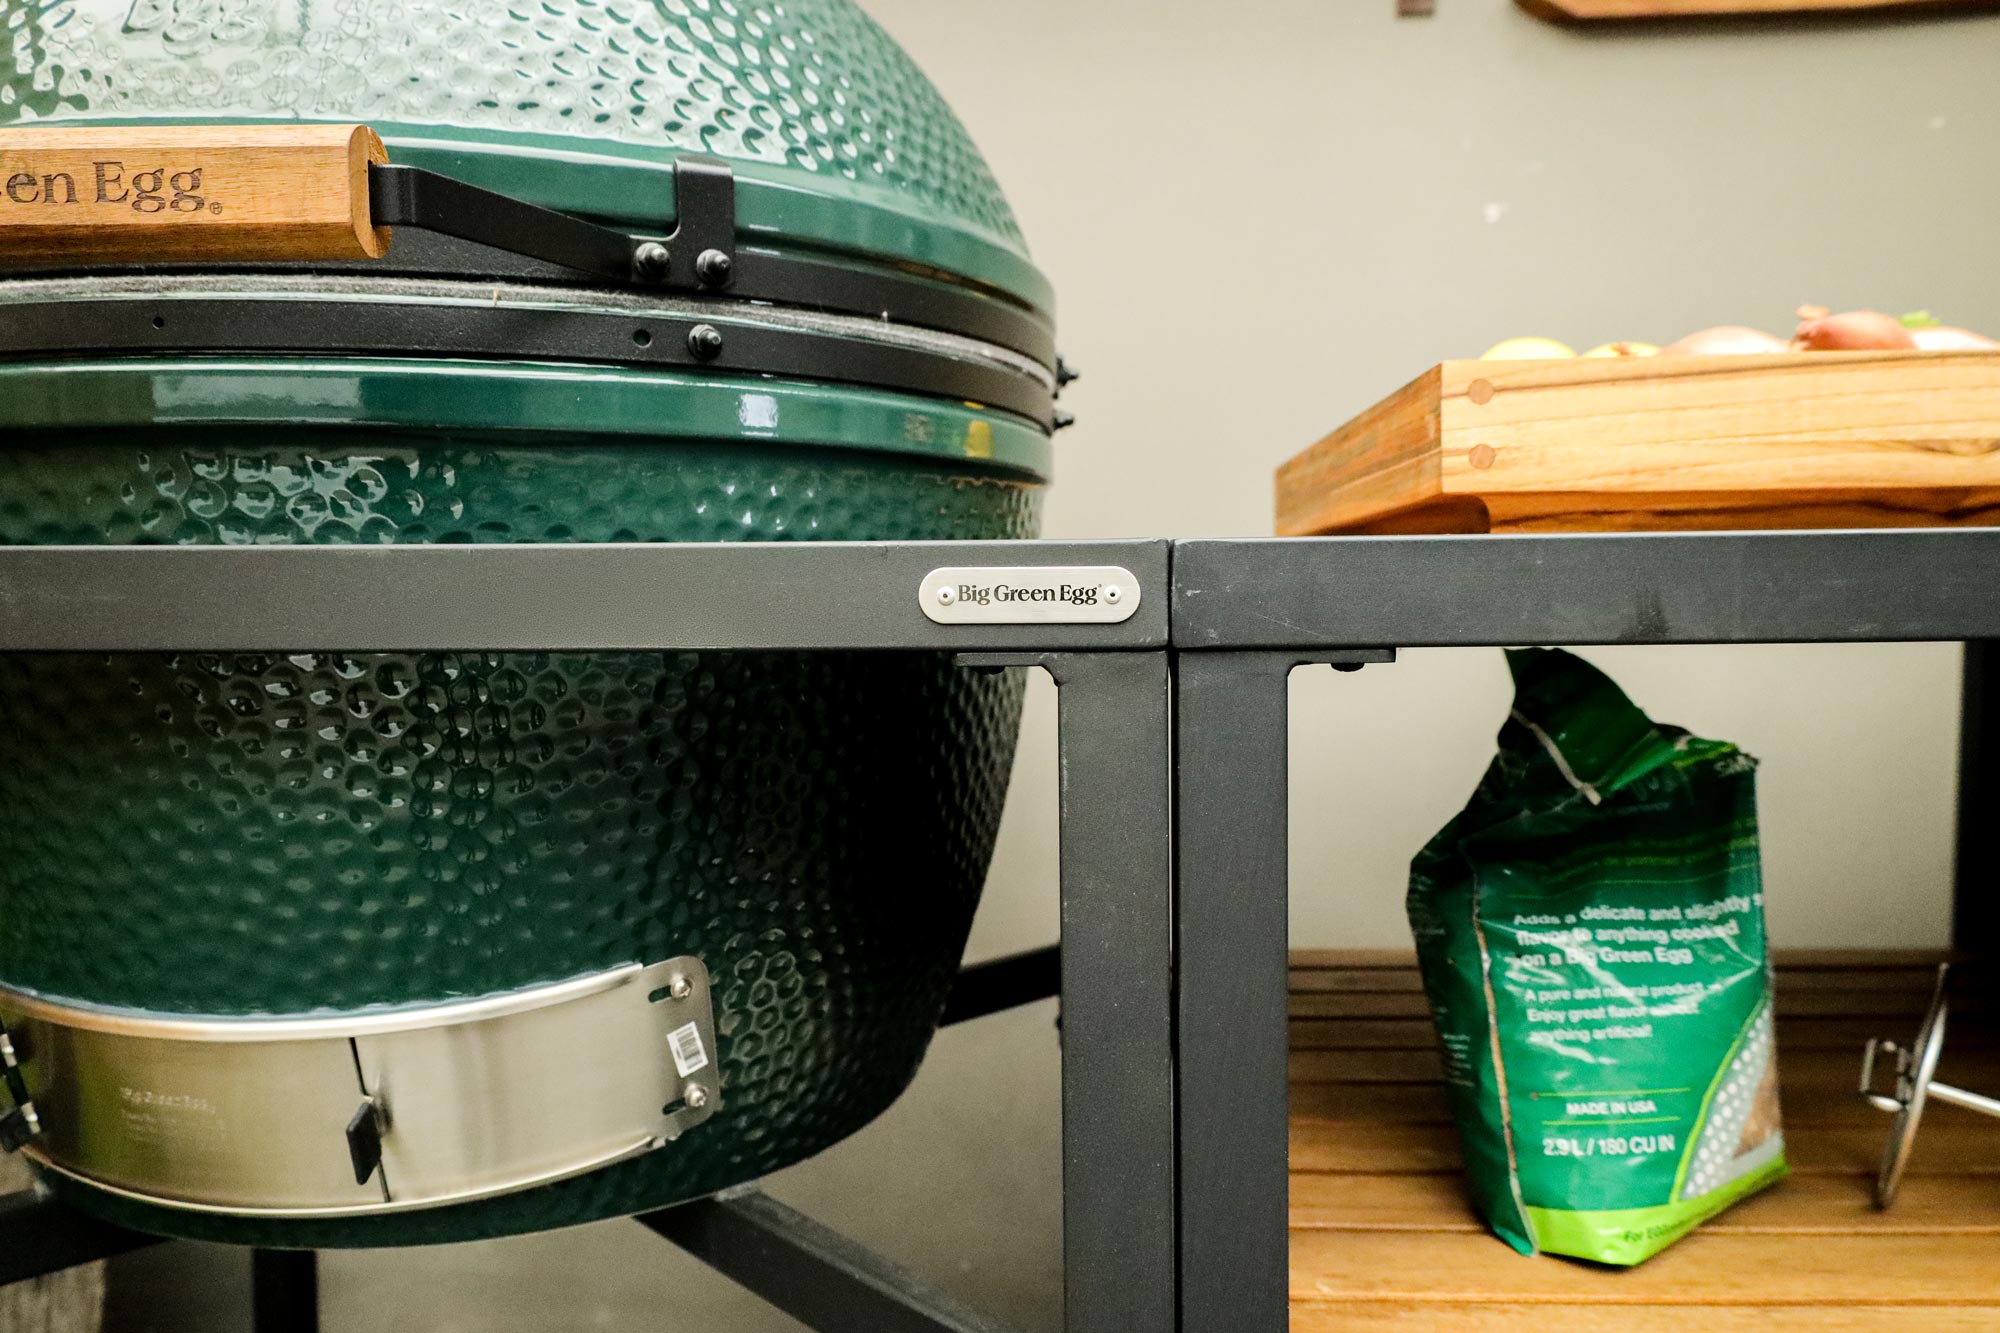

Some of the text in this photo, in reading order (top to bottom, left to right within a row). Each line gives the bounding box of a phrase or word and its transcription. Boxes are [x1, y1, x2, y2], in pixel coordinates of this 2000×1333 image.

[0, 173, 79, 203] en
[958, 584, 990, 606] Big
[994, 584, 1055, 602] Green
[1514, 914, 1560, 925] Adds
[1564, 914, 1577, 924] a
[1579, 904, 1646, 920] delicate
[1648, 905, 1682, 920] and
[1684, 895, 1751, 920] slightly
[1572, 927, 1593, 942] to
[1595, 927, 1670, 946] anything
[1548, 952, 1563, 966] a
[1600, 946, 1654, 963] Green
[1654, 946, 1694, 965] Egg
[1538, 989, 1571, 1004] pure
[1573, 986, 1601, 999] and
[1602, 985, 1649, 998] naral
[1526, 1009, 1566, 1024] Enjoy
[1567, 1006, 1606, 1023] great
[1528, 1029, 1591, 1044] thing
[1566, 1099, 1658, 1115] MADE IN USA
[1629, 1135, 1656, 1154] CU
[1657, 1133, 1675, 1152] IN
